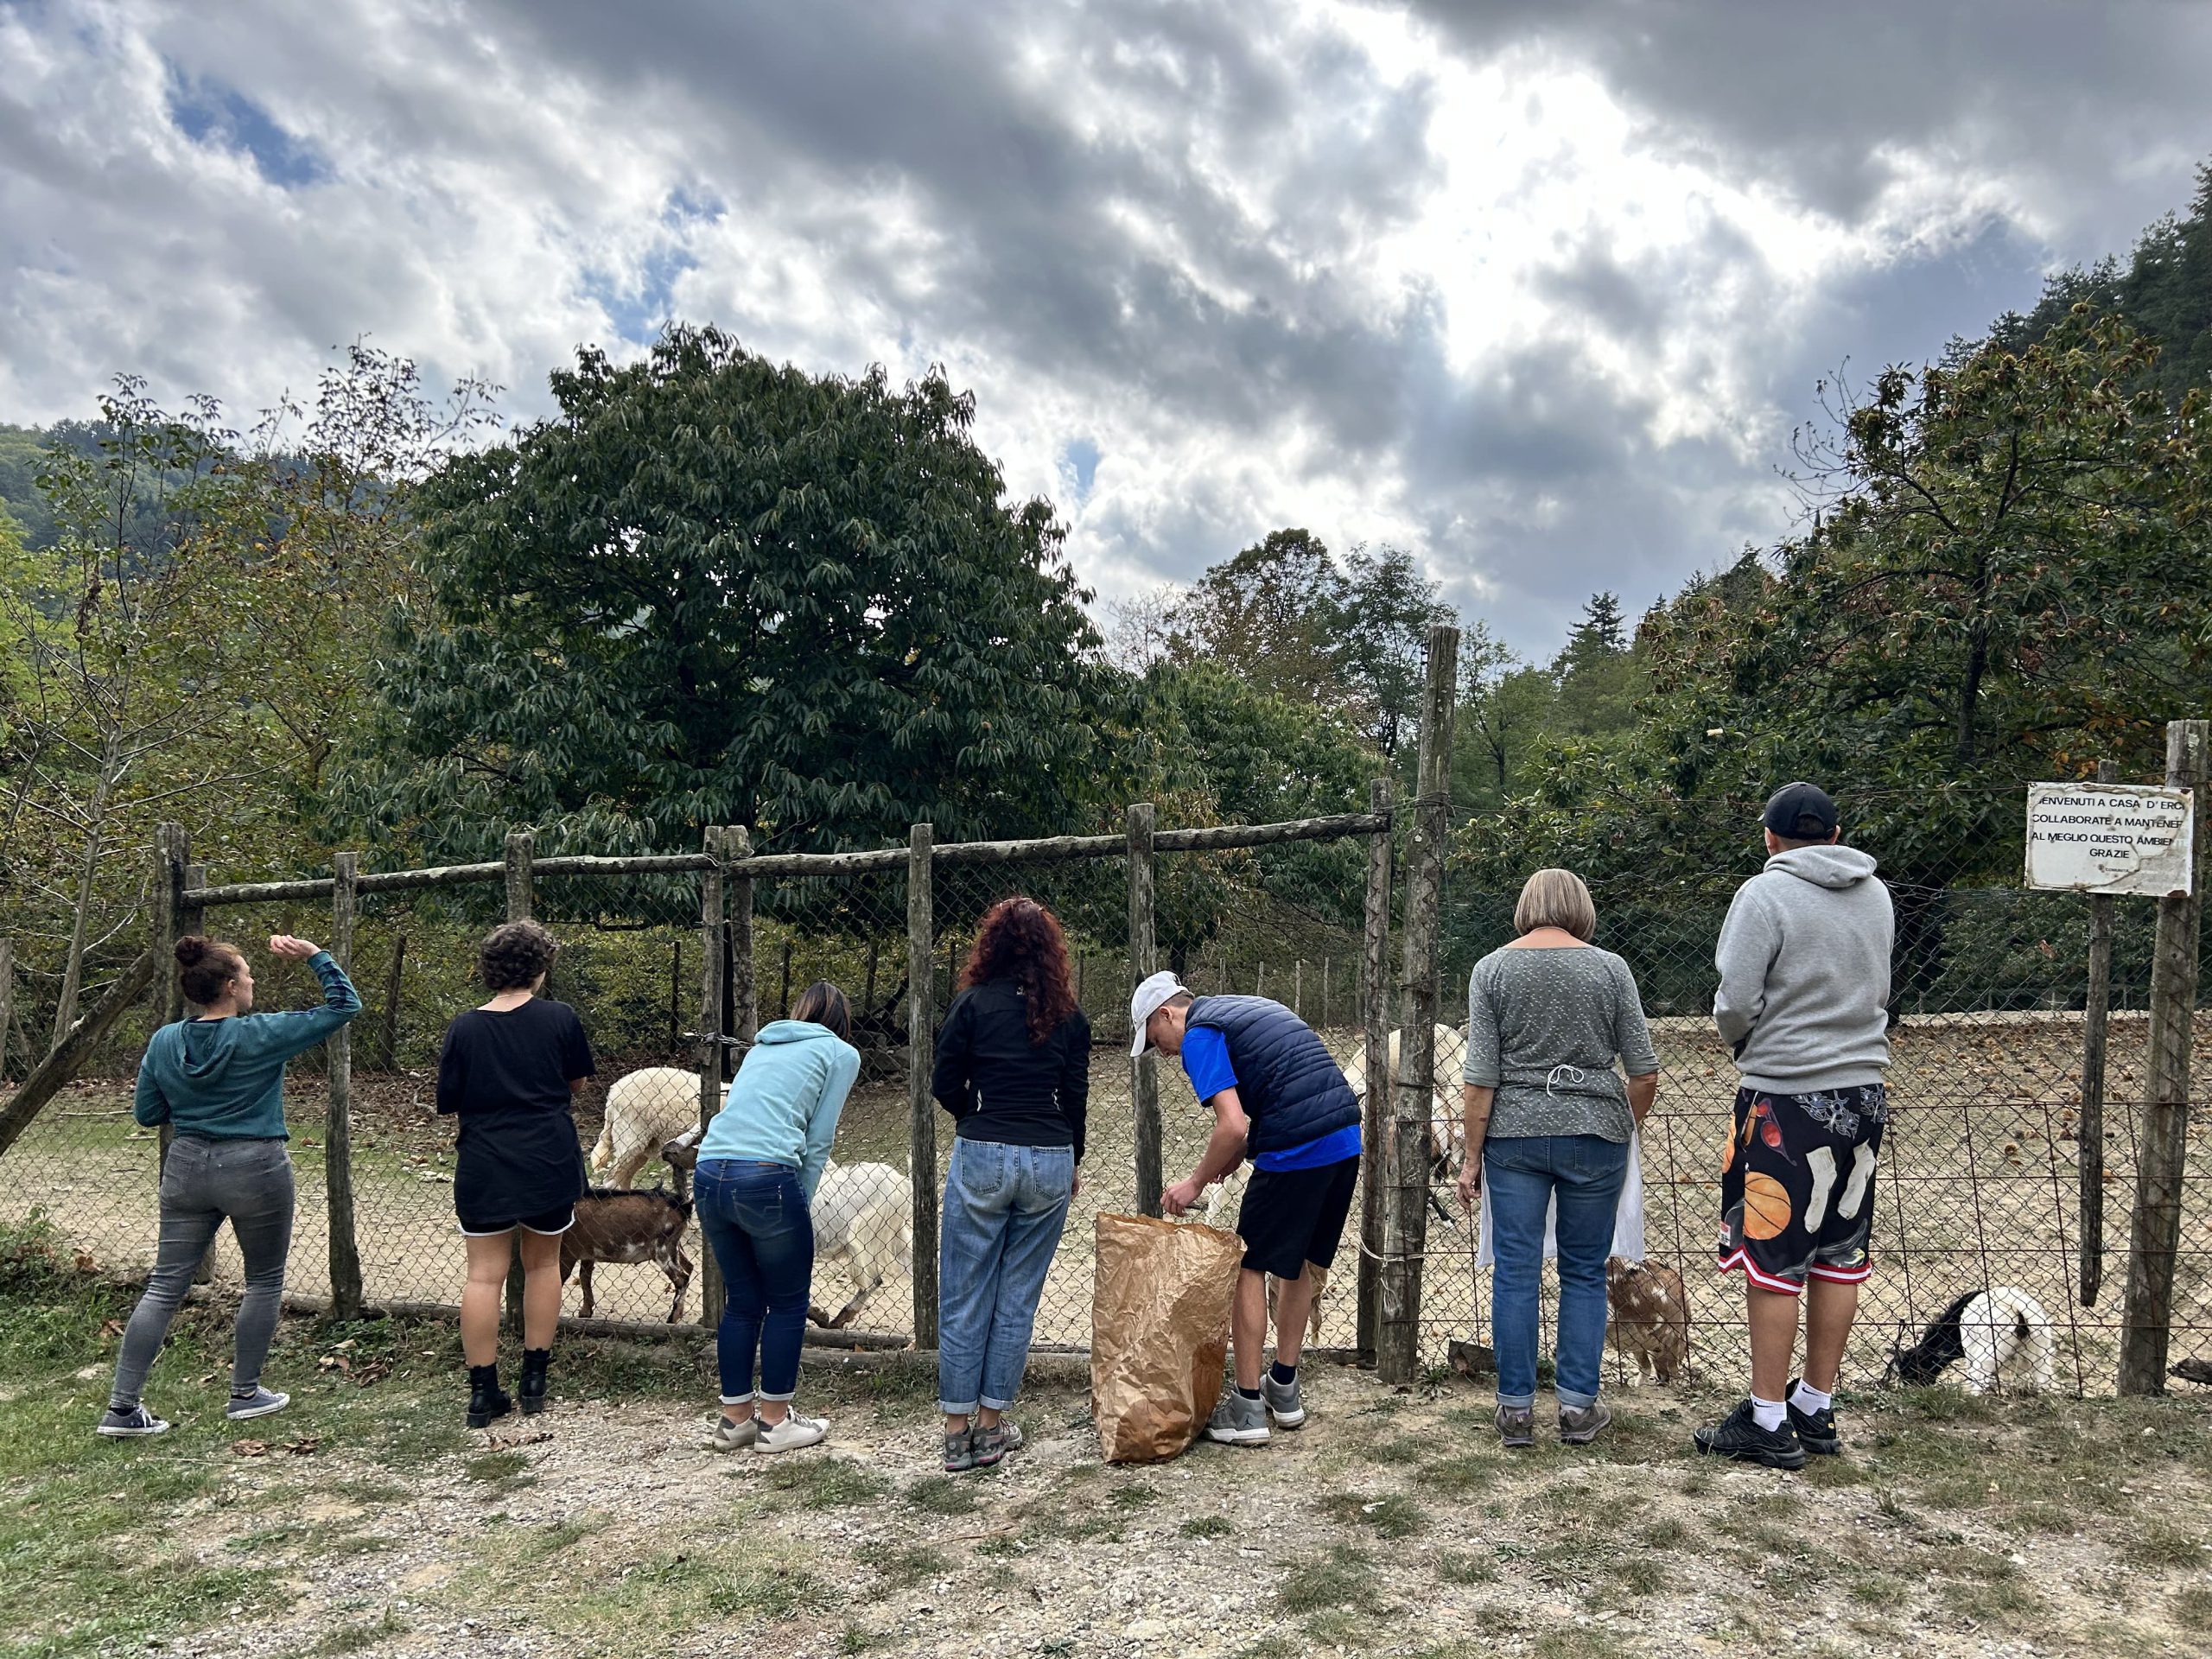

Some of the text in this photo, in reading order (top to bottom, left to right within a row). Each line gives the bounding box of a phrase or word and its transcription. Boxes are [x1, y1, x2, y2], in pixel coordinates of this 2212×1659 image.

[2097, 798, 2107, 807] A
[2109, 798, 2140, 809] CASA
[2032, 814, 2112, 825] COLLABORATE
[2031, 832, 2045, 841] AL
[2048, 833, 2088, 842] MEGLIO
[2089, 834, 2133, 844] QUESTO
[2089, 848, 2130, 859] GRAZIE
